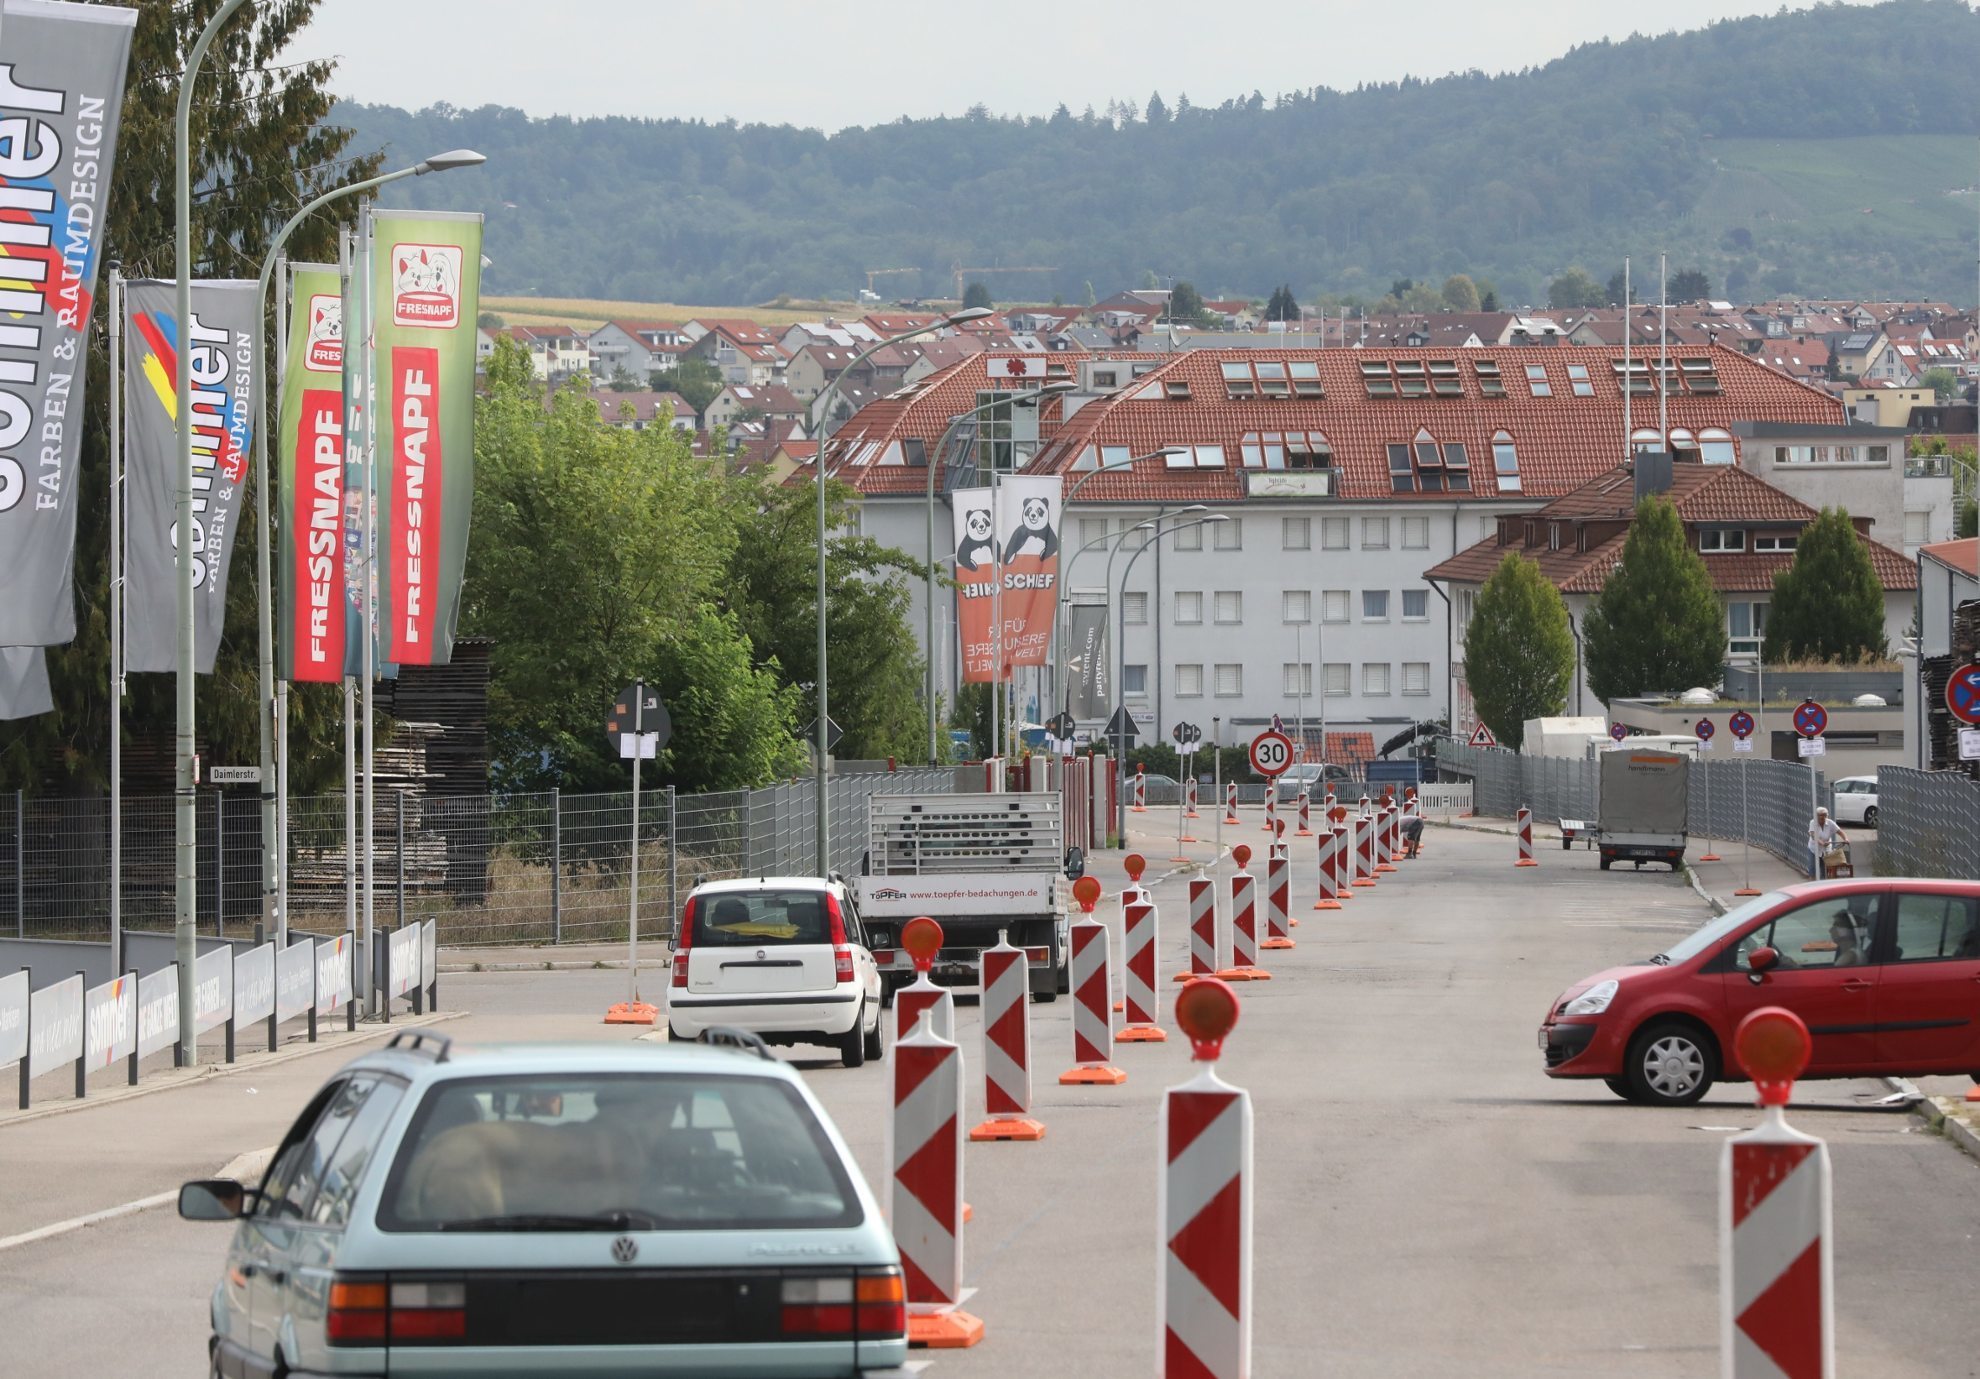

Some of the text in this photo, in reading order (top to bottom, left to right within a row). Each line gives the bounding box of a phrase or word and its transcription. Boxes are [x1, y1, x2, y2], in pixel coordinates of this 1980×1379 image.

[36, 94, 106, 511] FARBEN & RAUMDESIGN
[222, 331, 252, 481] RAUMDESIGN
[218, 486, 234, 501] &
[404, 369, 432, 643] FRESSNAPF
[308, 410, 342, 663] FRESSNAPF
[214, 769, 256, 779] Daimlerstr.
[1259, 743, 1284, 764] 30
[909, 889, 1038, 899] www.toepfer-bedachungen.de
